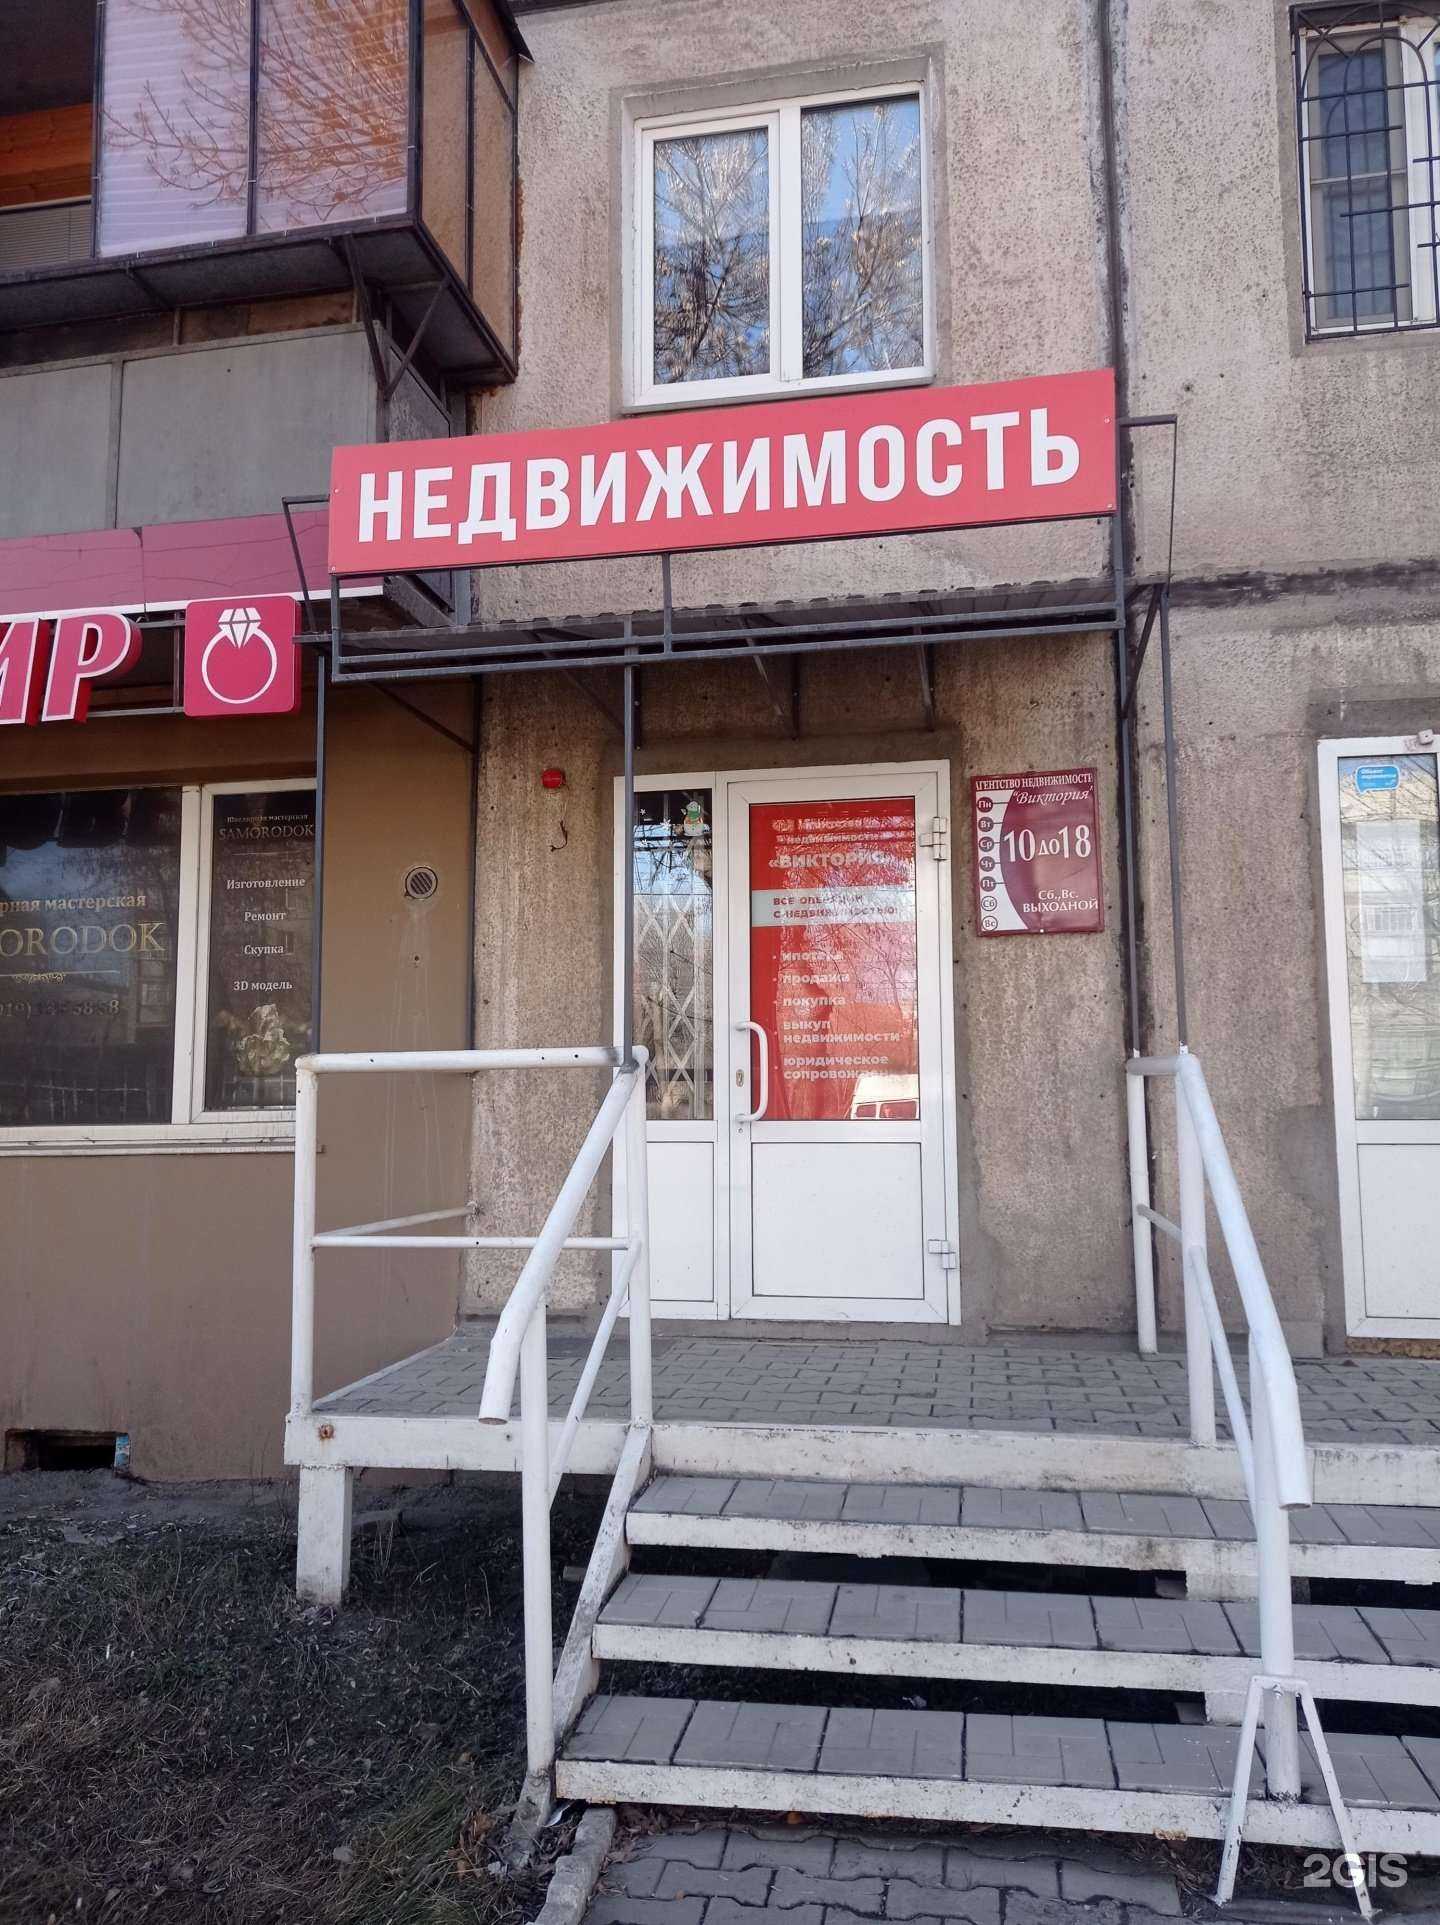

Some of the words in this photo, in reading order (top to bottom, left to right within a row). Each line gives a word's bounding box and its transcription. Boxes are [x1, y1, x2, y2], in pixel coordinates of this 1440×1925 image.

[357, 407, 1081, 545] НЕДВИЖИМОСТЬ
[978, 800, 992, 808] Пн
[980, 820, 992, 829] Вт
[219, 824, 314, 841] SAMORODOK
[980, 839, 993, 848] Ср
[1004, 828, 1036, 863] 10
[1058, 824, 1091, 859] 18
[226, 877, 306, 890] Изготовление
[982, 879, 994, 888] Пт
[44, 895, 147, 912] мастерская
[773, 896, 795, 906] ВСЕ
[983, 900, 995, 908] Сб
[1023, 897, 1099, 913] ВЫХОДНОЙ
[244, 911, 286, 921] Ремонт
[785, 906, 898, 919] НЕДВИЖОСТЬЮ!
[985, 919, 996, 928] Вс
[0, 922, 168, 957] ORODOK
[244, 944, 284, 955] Скупка
[233, 980, 249, 991] 3D
[251, 979, 293, 992] модель
[783, 1020, 831, 1031] выкуп
[783, 1032, 900, 1044] недвижимости
[783, 1055, 889, 1067] юридическое
